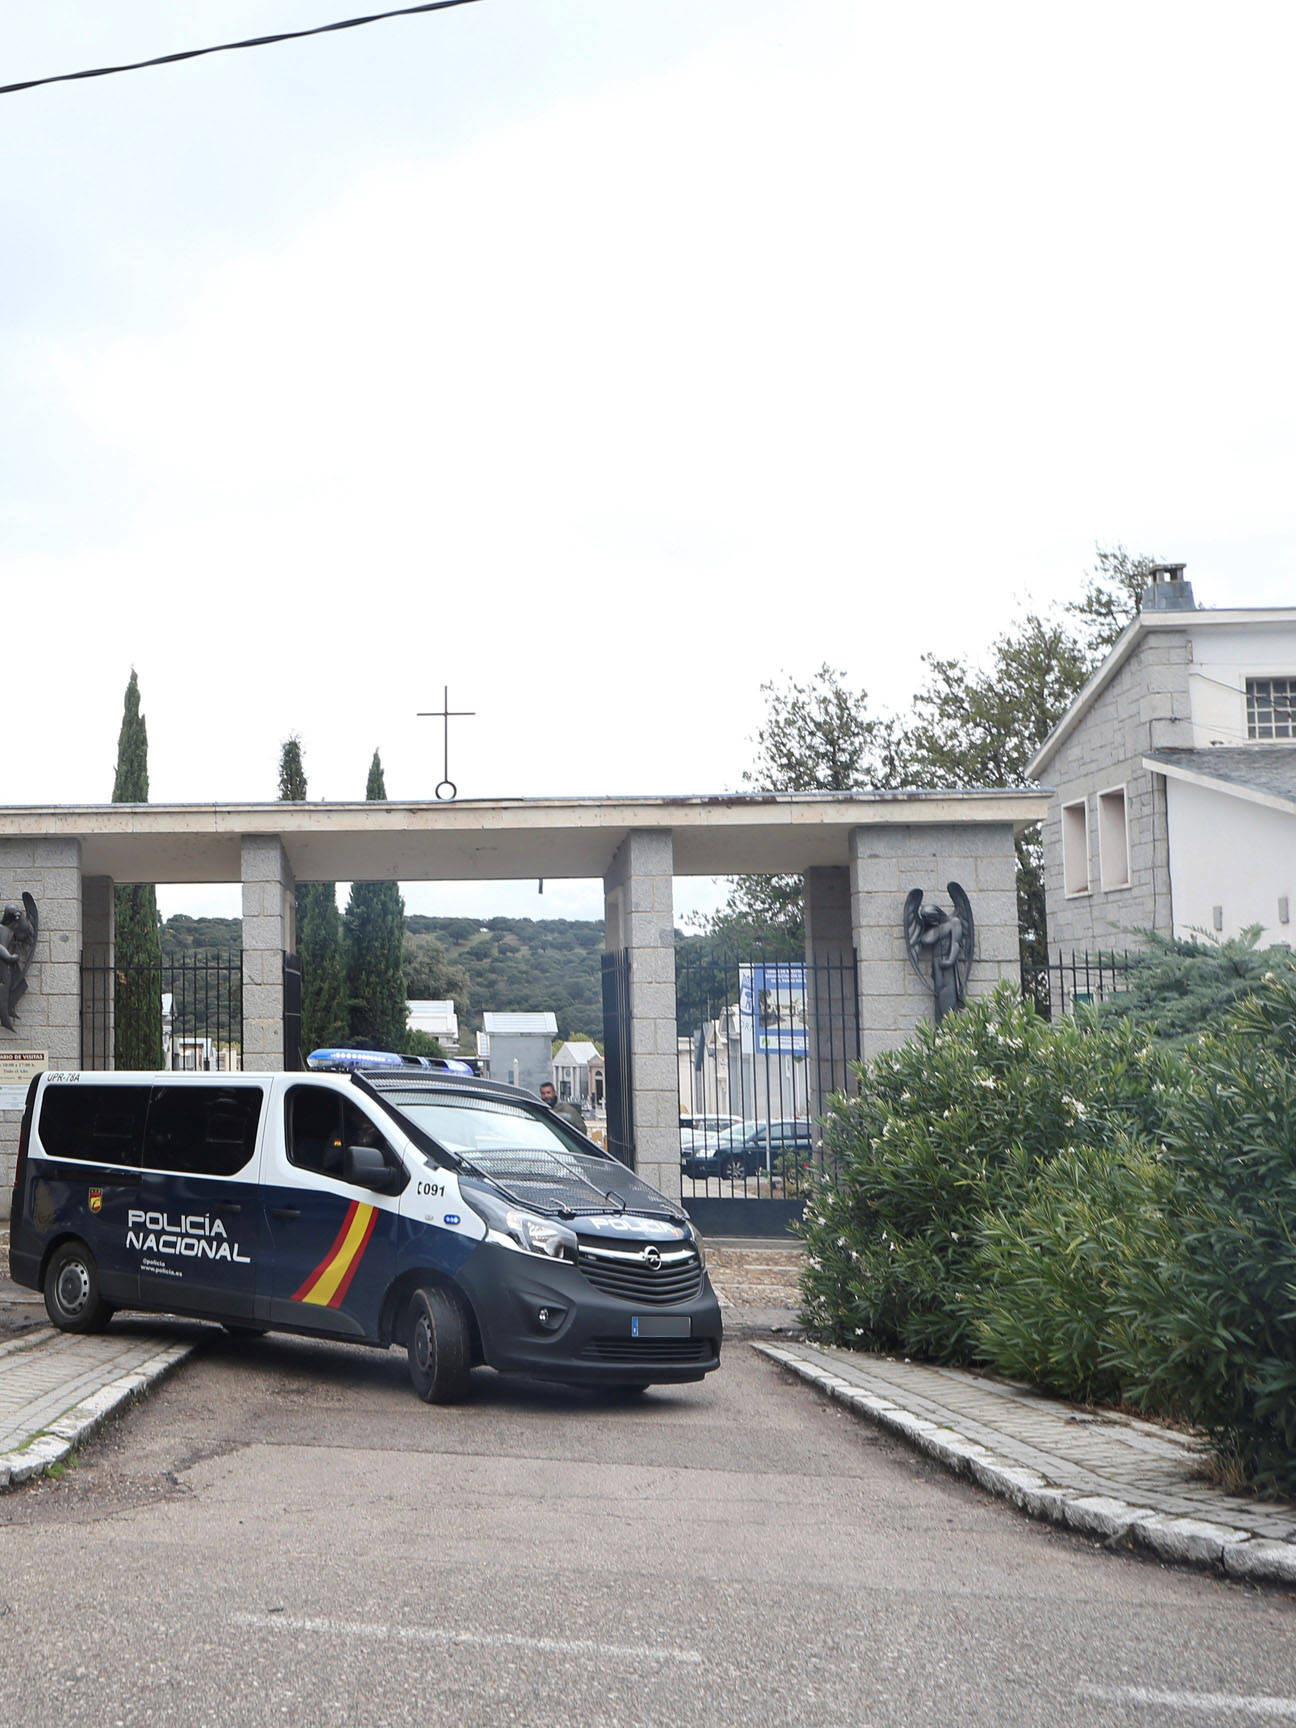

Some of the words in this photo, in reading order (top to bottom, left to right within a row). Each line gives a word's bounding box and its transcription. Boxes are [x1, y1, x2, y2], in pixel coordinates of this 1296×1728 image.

[423, 1183, 445, 1197] 091
[128, 1209, 228, 1238] POLICÍA
[125, 1230, 251, 1264] NACIONAL
[140, 1264, 183, 1278] www.policia.es
